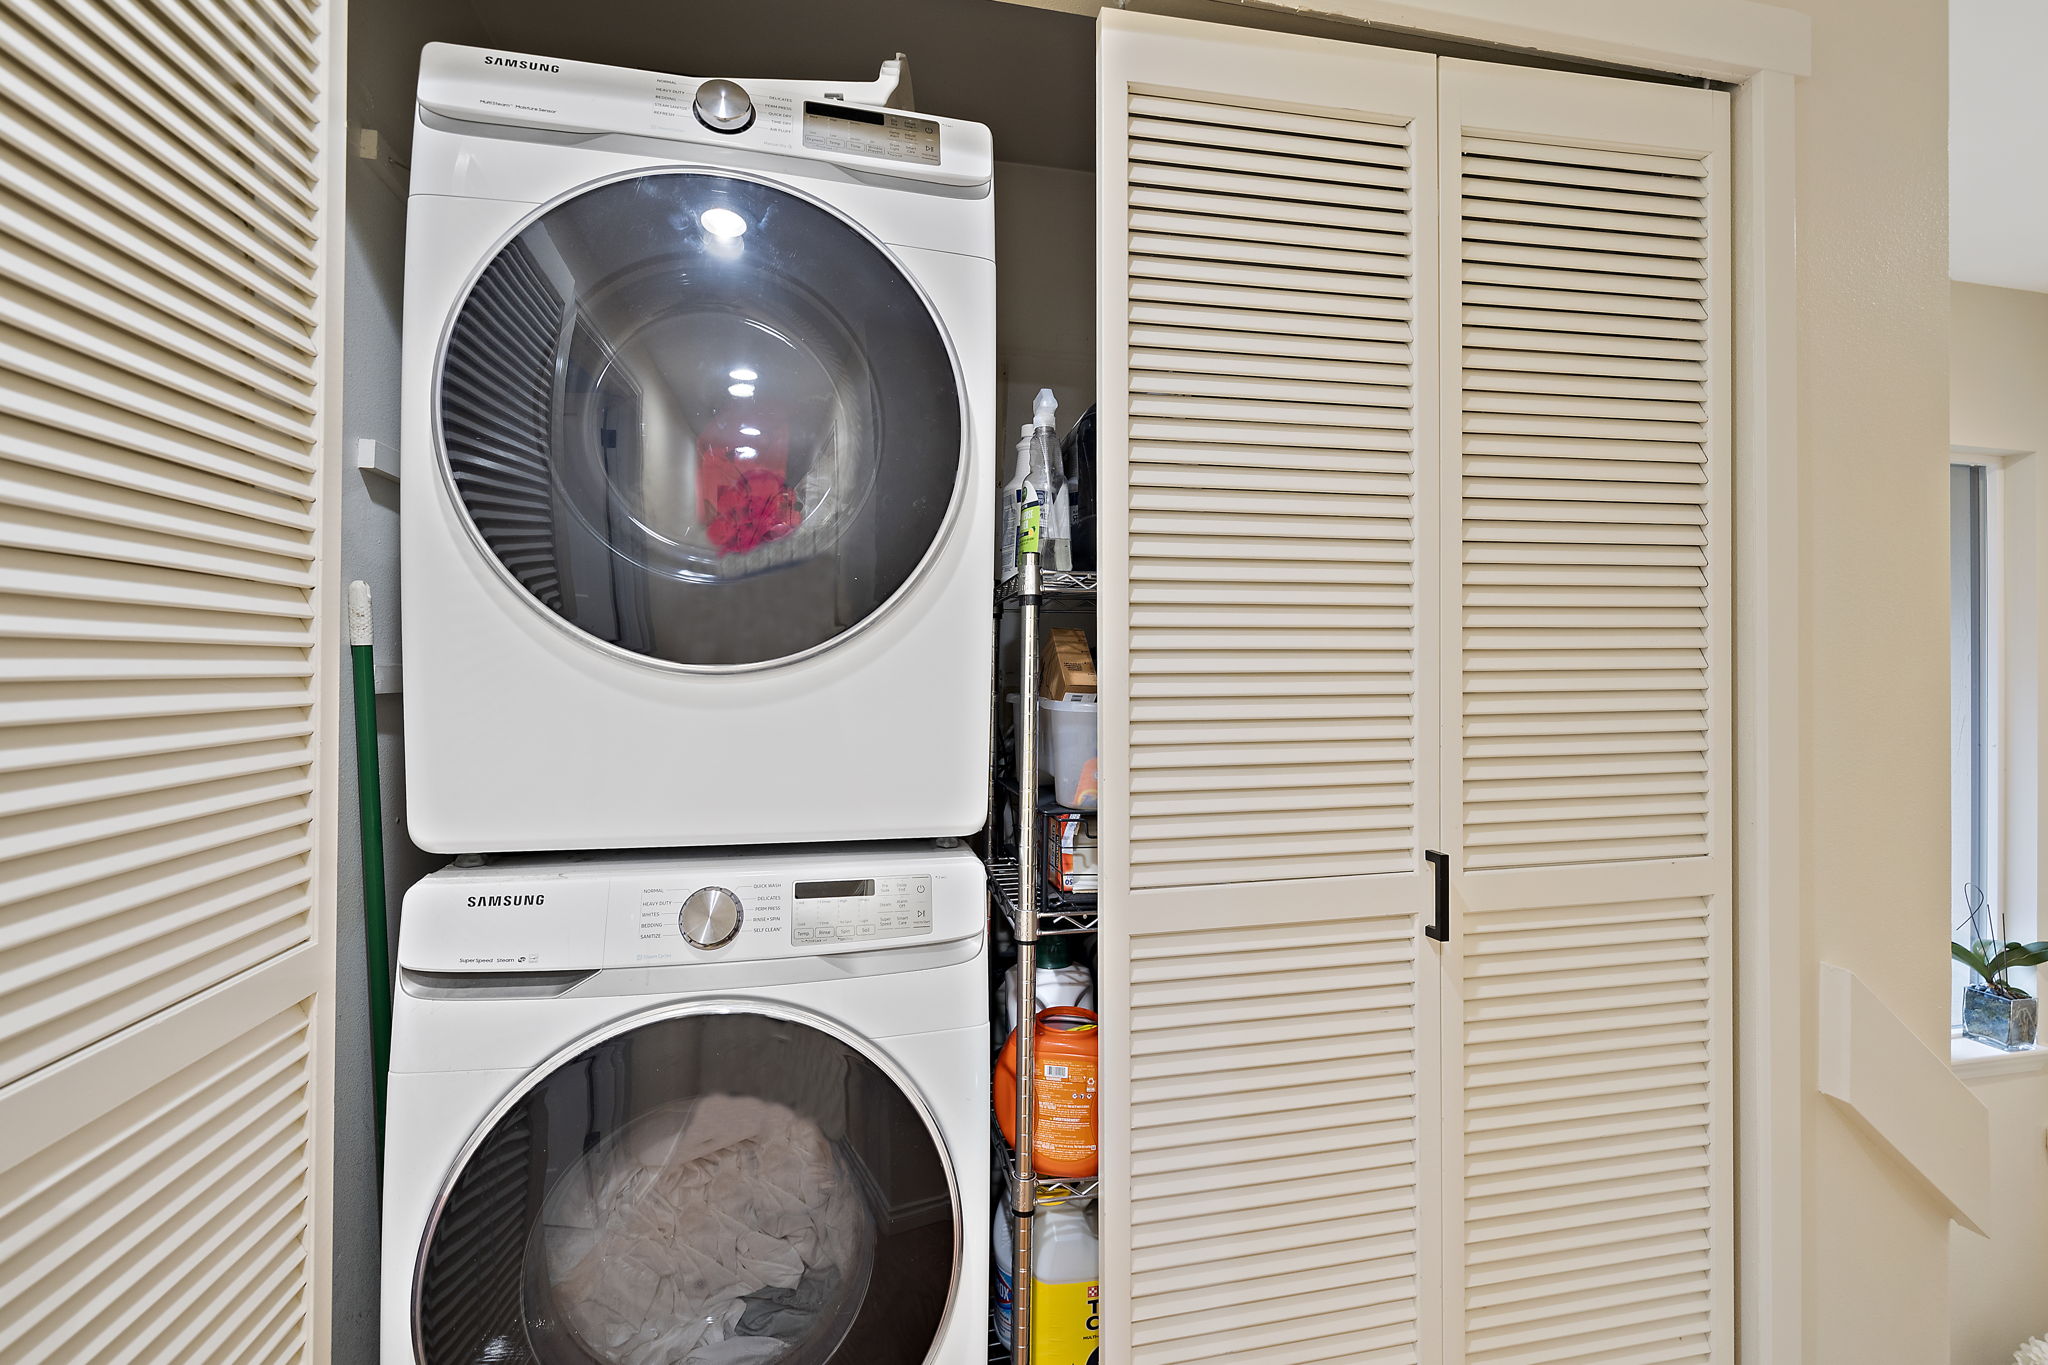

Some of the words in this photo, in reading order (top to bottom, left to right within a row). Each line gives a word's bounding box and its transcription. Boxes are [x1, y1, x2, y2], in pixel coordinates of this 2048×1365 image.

[484, 55, 560, 73] SAMSUNG
[769, 95, 793, 103] DELICATES
[467, 894, 545, 908] SAMSUNG
